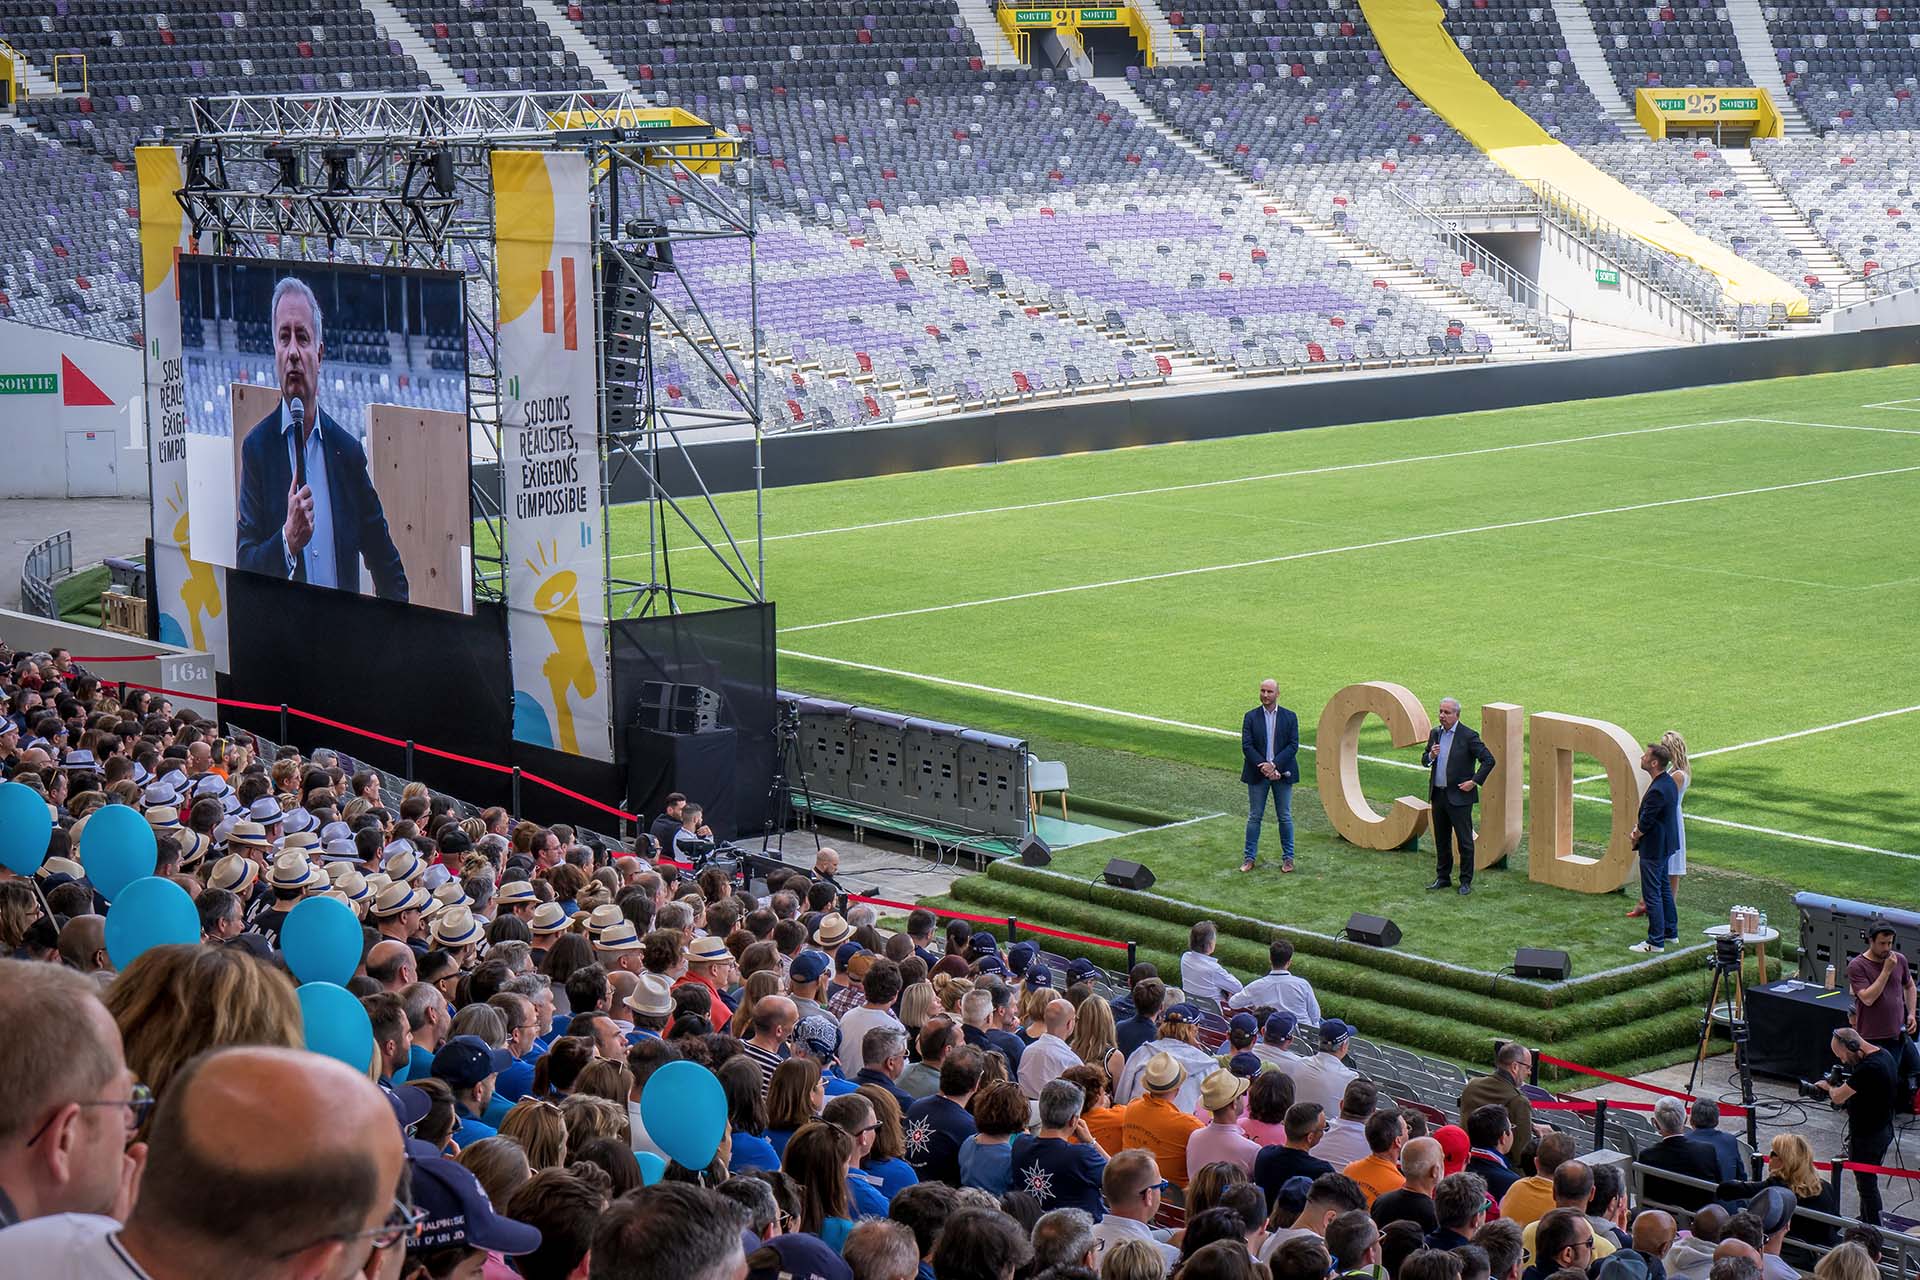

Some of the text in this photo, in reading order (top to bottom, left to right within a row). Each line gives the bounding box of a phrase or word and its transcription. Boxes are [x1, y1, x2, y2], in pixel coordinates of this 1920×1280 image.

[1017, 11, 1050, 21] SORTIE
[1082, 10, 1115, 19] SORTIE
[1687, 95, 1717, 114] 23
[1721, 100, 1756, 108] SORTIE
[1599, 271, 1616, 283] SORTIE
[524, 395, 571, 427] SOYONS
[169, 662, 208, 682] 16a
